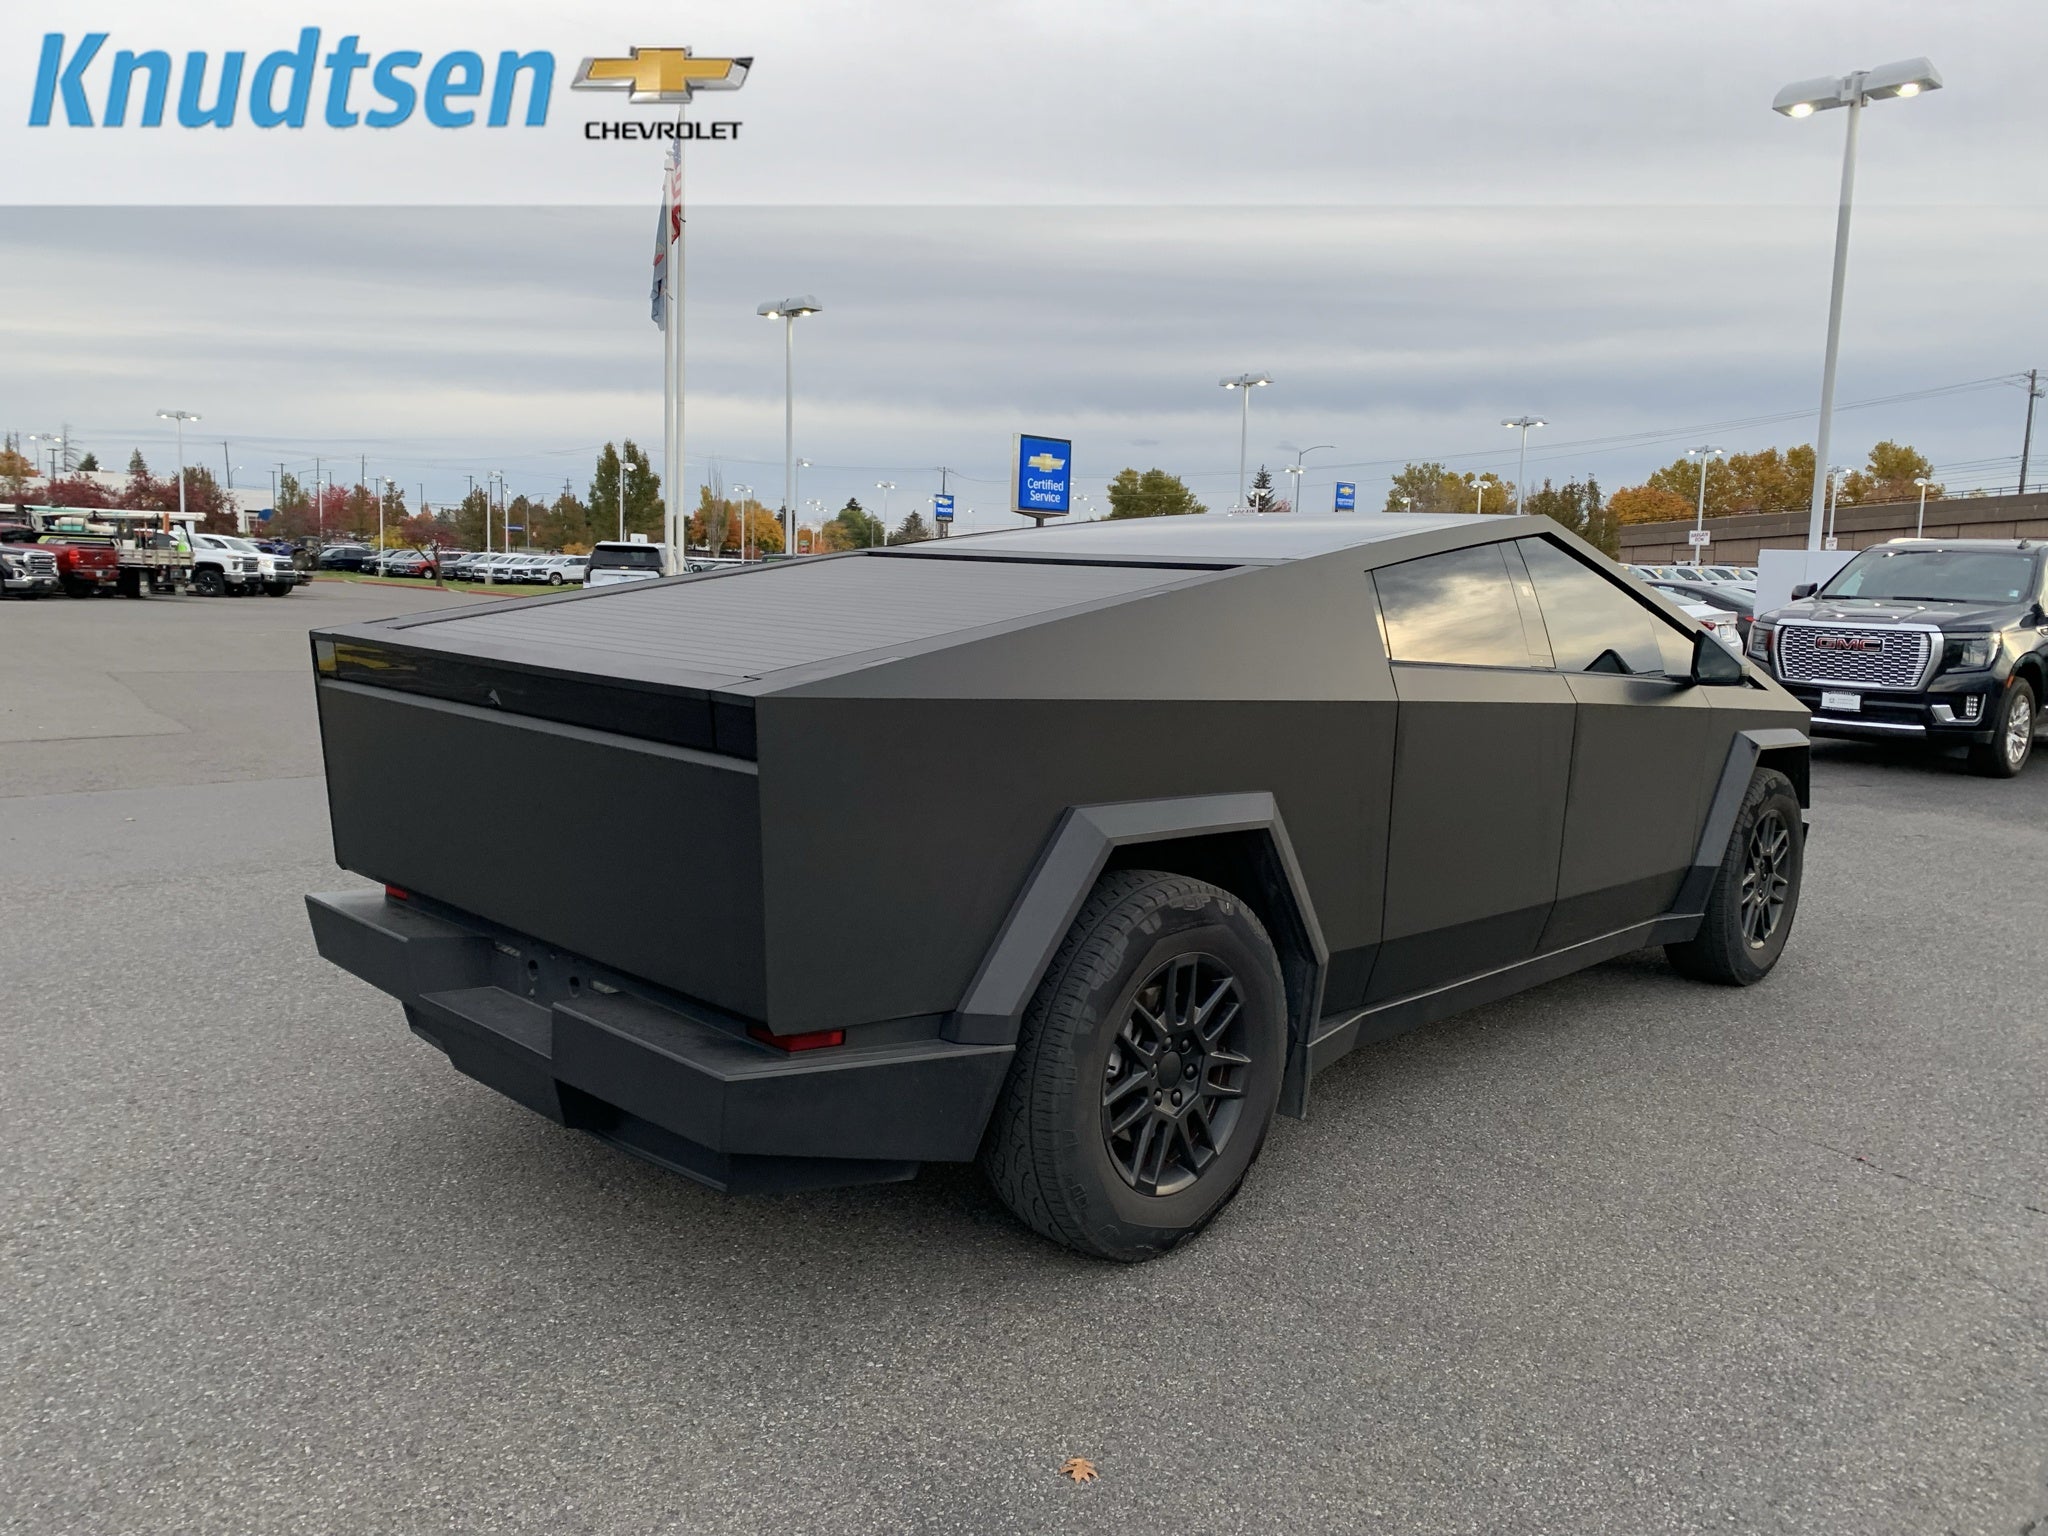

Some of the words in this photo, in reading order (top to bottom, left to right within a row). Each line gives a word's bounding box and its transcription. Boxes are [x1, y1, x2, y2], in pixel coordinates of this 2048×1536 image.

[1027, 478, 1064, 491] Certified
[1030, 490, 1061, 503] Service
[1816, 637, 1882, 652] GMC
